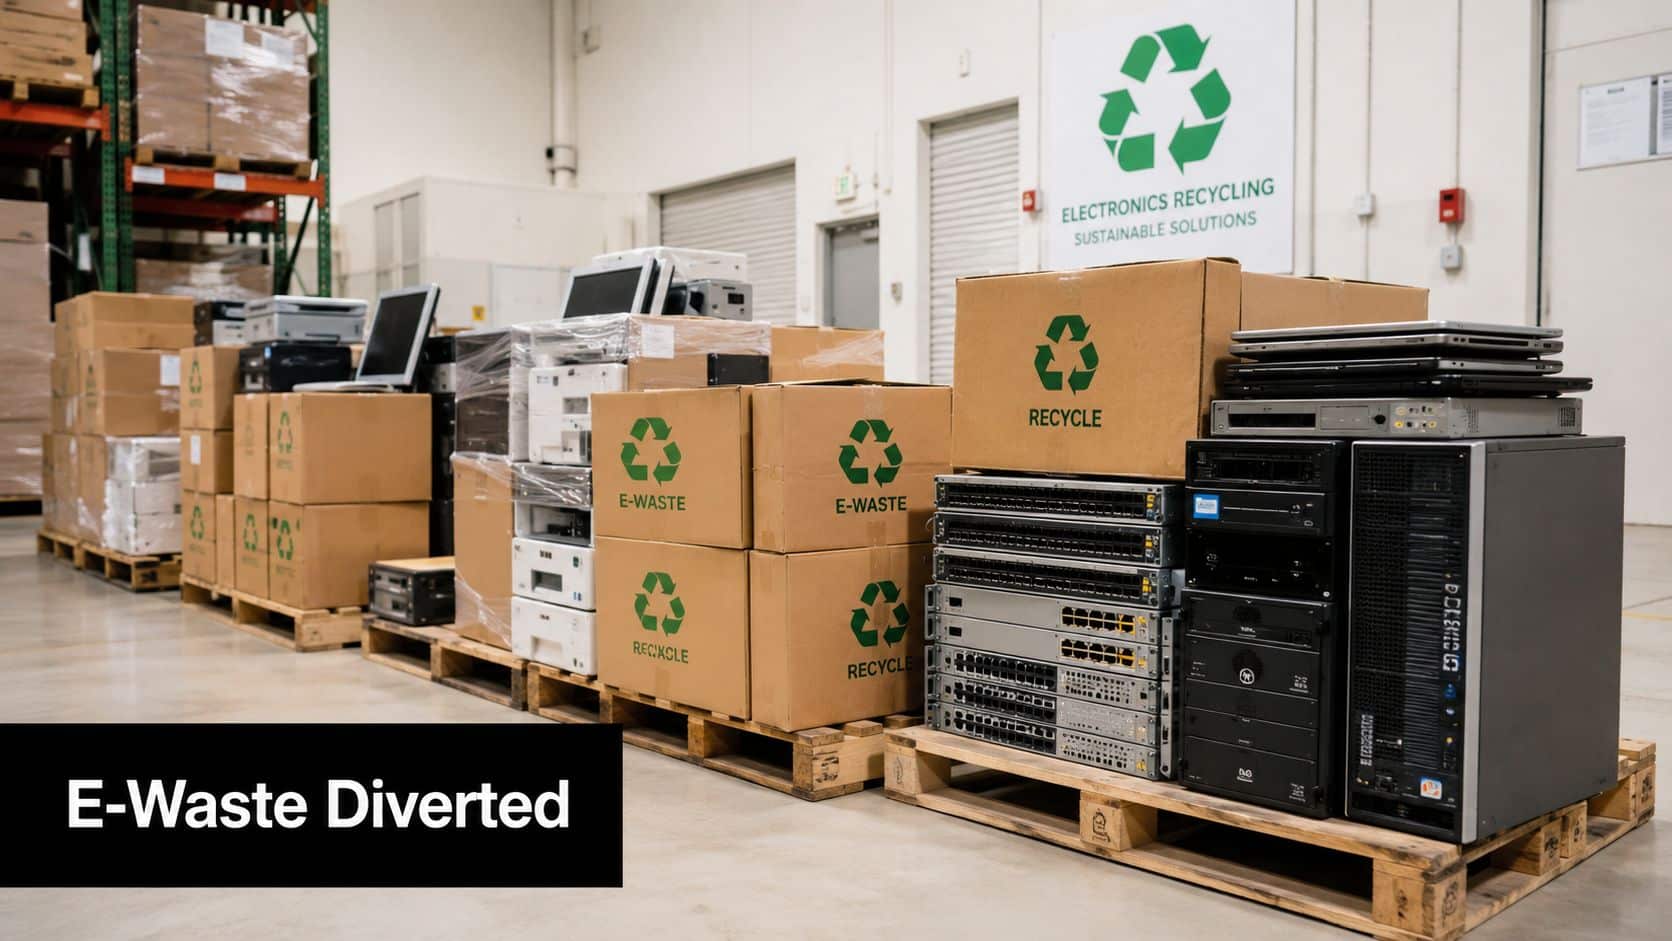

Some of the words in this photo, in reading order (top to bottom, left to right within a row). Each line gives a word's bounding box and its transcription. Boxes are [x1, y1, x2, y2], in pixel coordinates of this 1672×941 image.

[1062, 193, 1168, 223] ELECTRONICS
[1174, 178, 1275, 208] RECYCLING
[1075, 222, 1164, 246] SUSTAINABLE
[1170, 211, 1257, 235] SOLUTIONS
[1029, 408, 1102, 427] RECYCLE
[619, 493, 686, 511] E-WASTE
[836, 496, 907, 514] E-WASTE
[848, 656, 913, 680] RECYCLE
